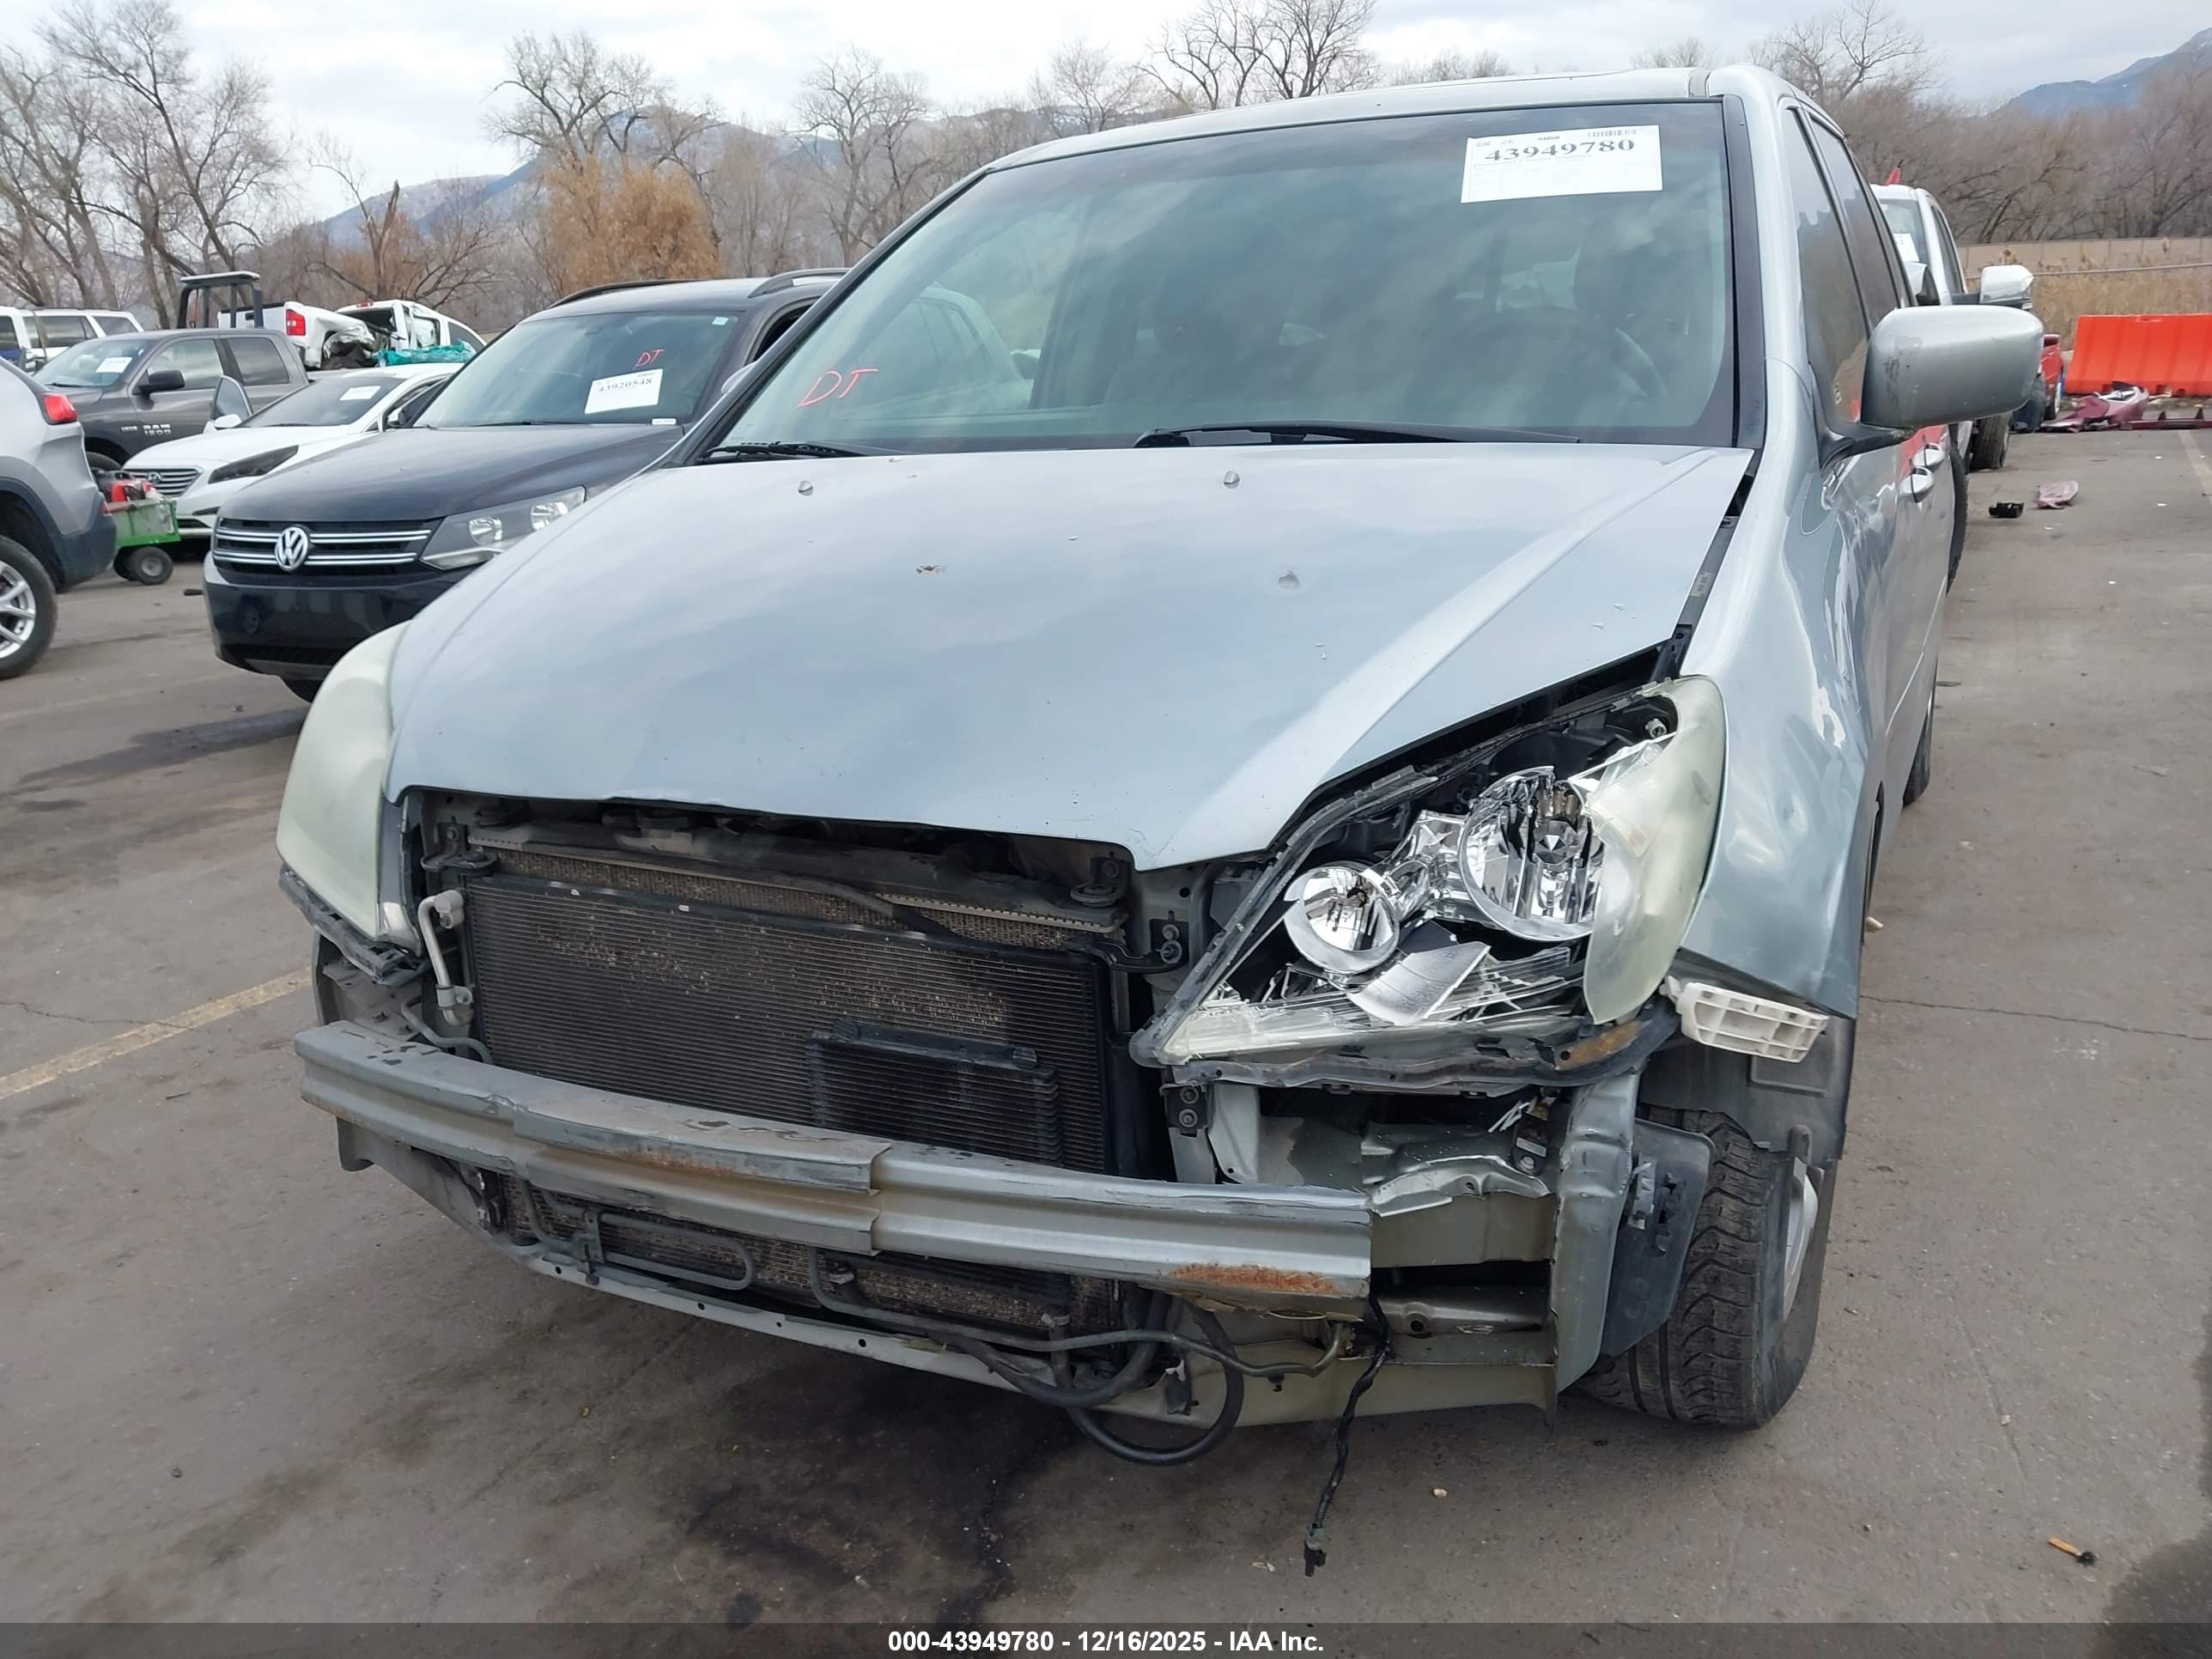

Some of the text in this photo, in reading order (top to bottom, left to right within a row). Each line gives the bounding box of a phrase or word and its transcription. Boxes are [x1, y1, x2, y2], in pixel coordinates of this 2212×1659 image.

[1485, 138, 1635, 161] 43949780
[633, 349, 665, 371] DT
[797, 368, 879, 409] DT
